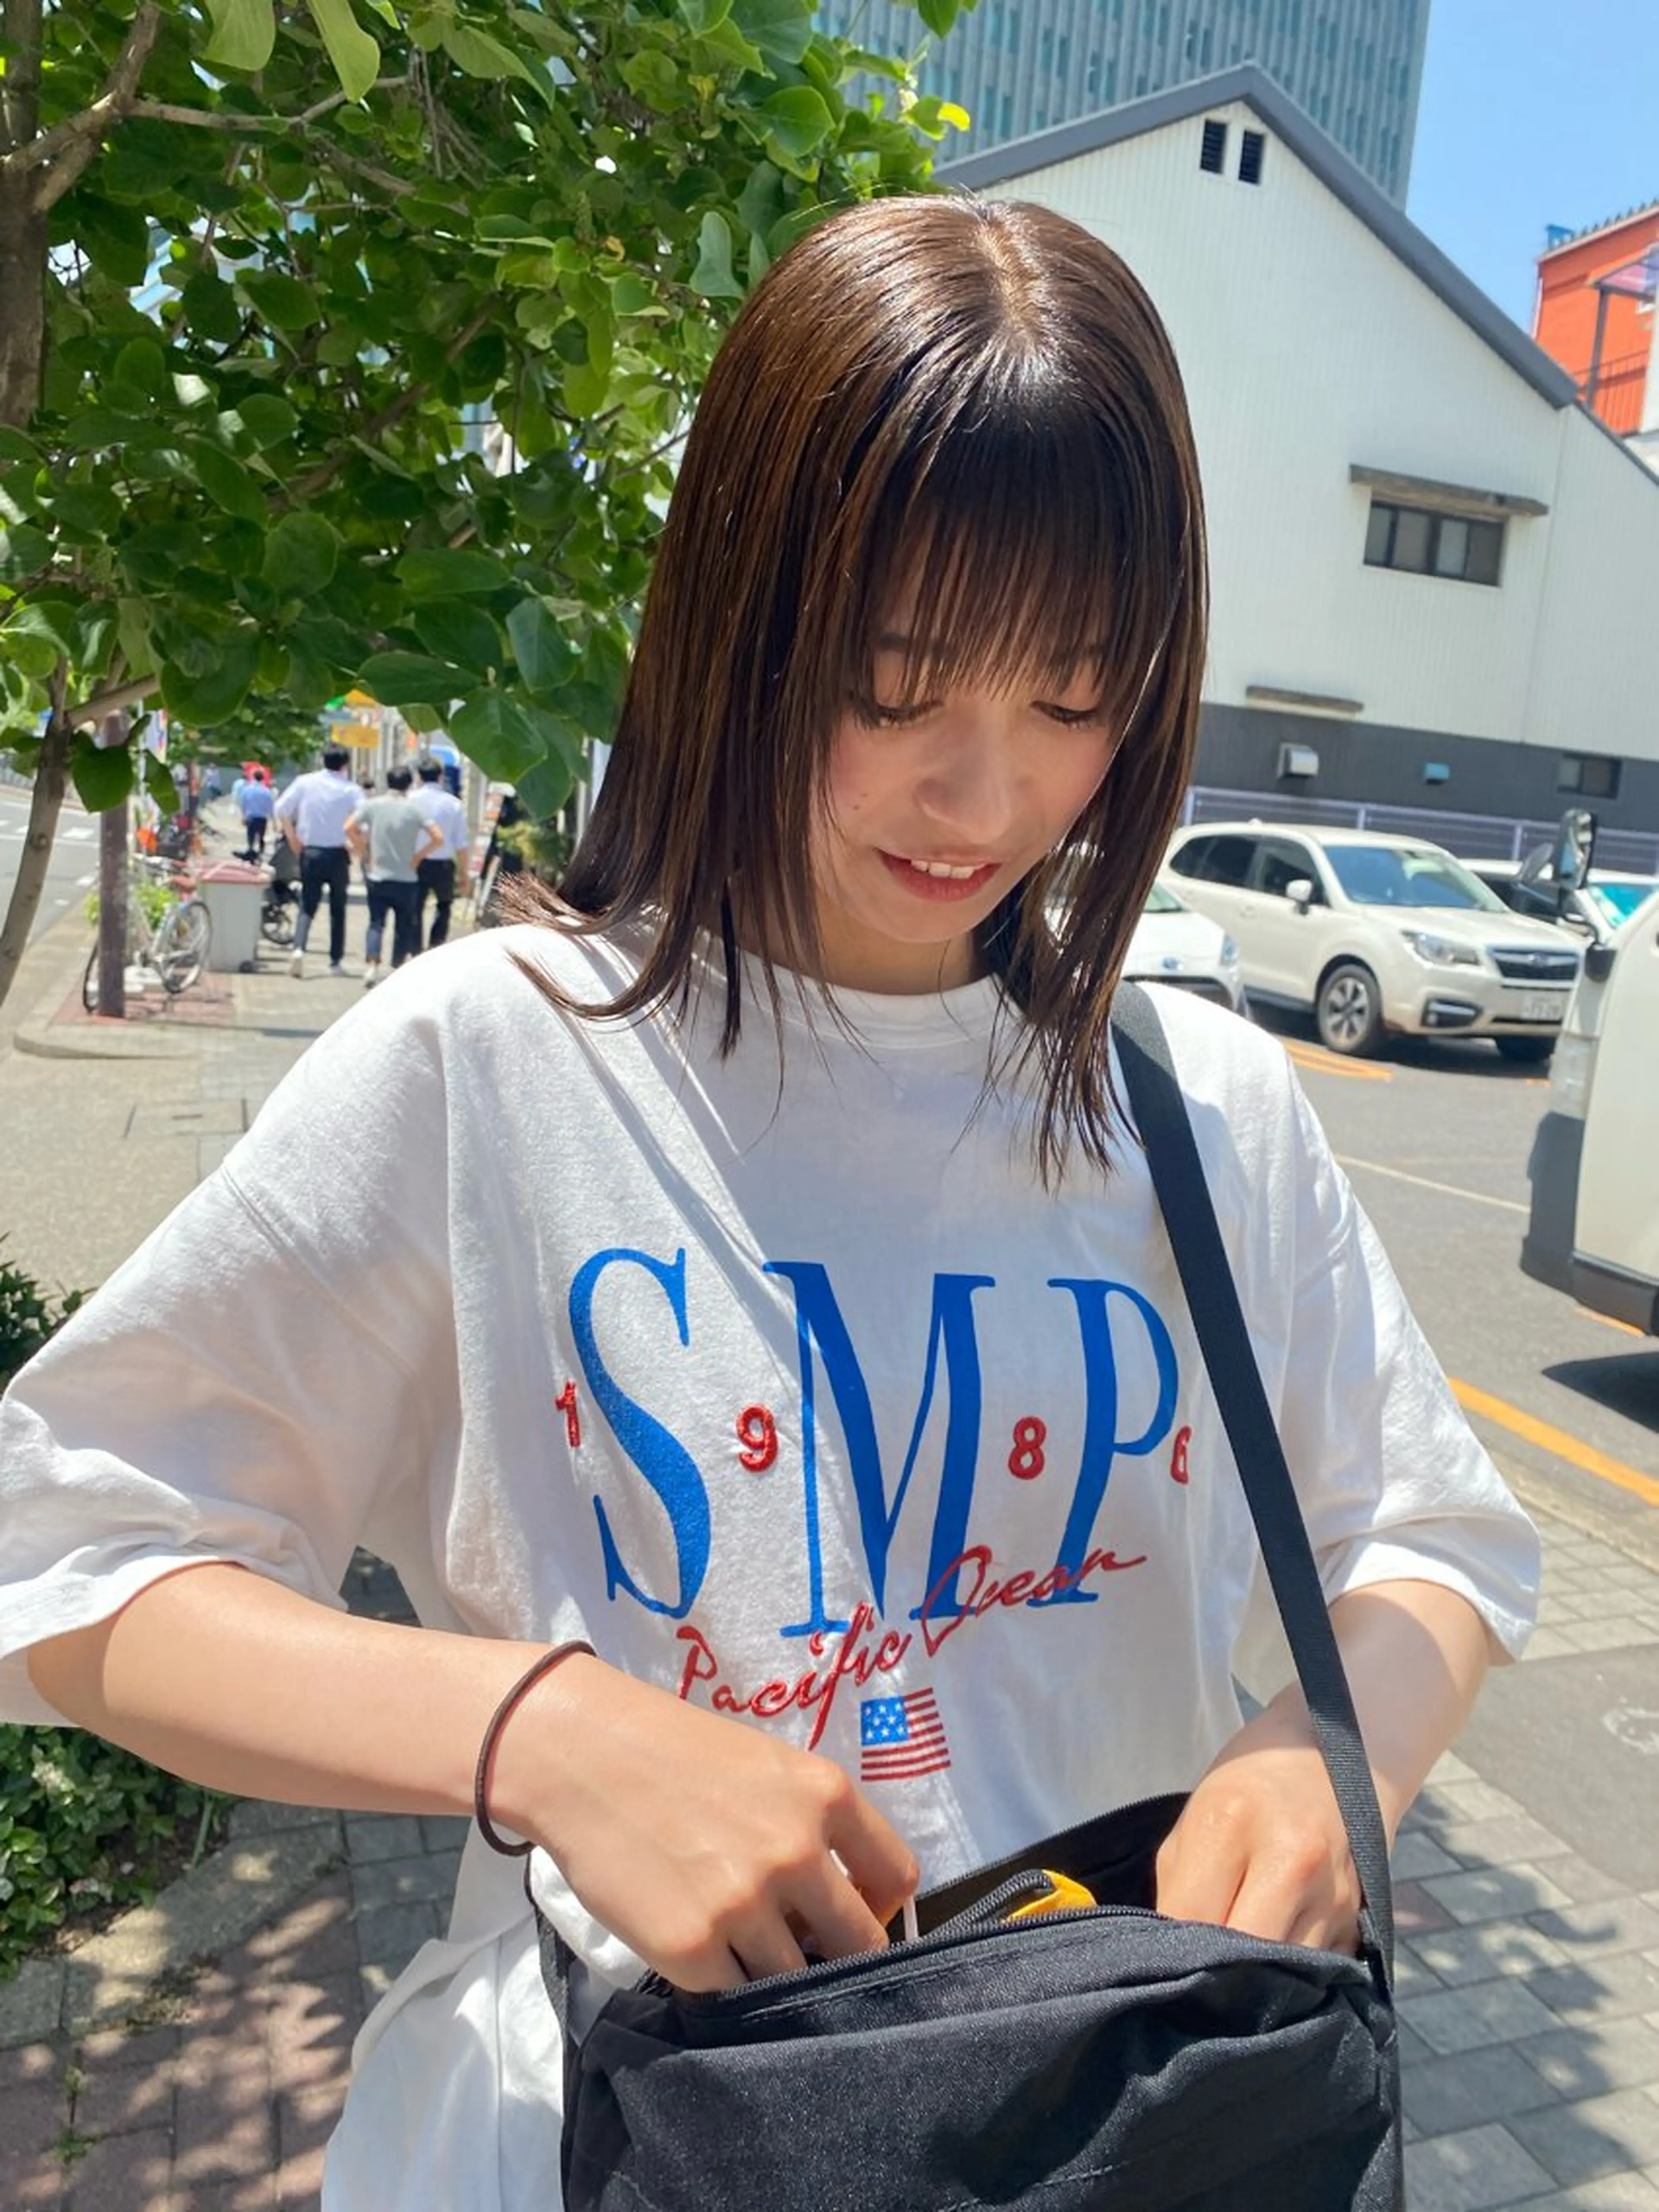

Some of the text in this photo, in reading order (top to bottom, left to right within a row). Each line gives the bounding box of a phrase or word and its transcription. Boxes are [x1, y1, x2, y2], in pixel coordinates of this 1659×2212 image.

[569, 1247, 1178, 1637] SMP
[676, 1544, 1148, 1751] Pacific Ocean
